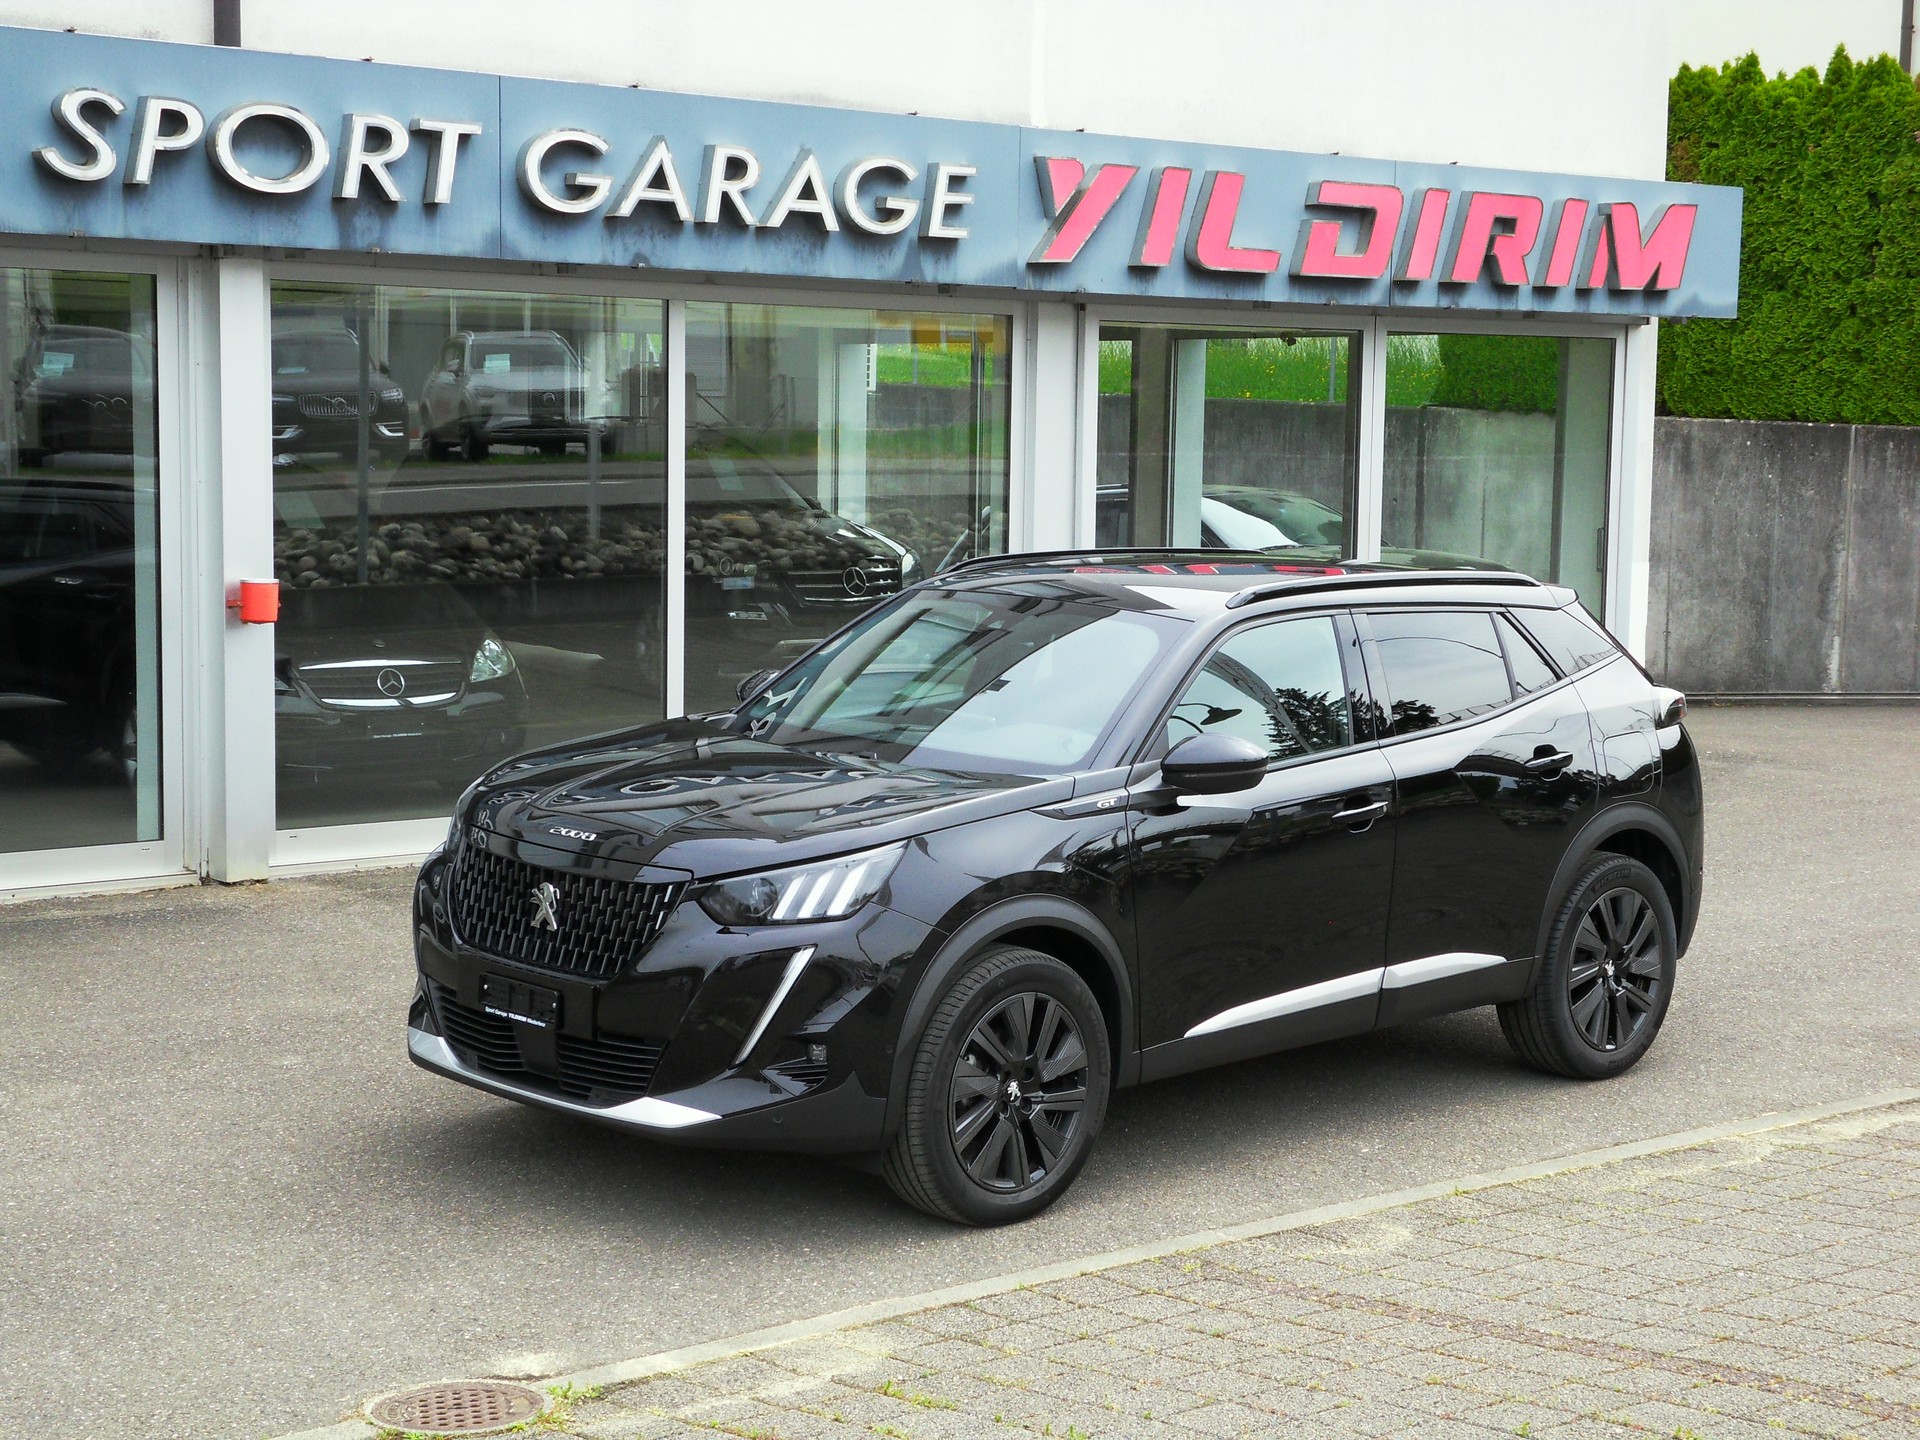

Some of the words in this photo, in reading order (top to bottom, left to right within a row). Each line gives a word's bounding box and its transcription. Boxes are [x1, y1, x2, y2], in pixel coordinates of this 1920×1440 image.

[32, 86, 482, 205] SPORT
[516, 127, 978, 240] GARAGE
[1026, 156, 1698, 291] YILDIRIM
[1097, 798, 1117, 808] GT
[549, 825, 597, 841] 2008
